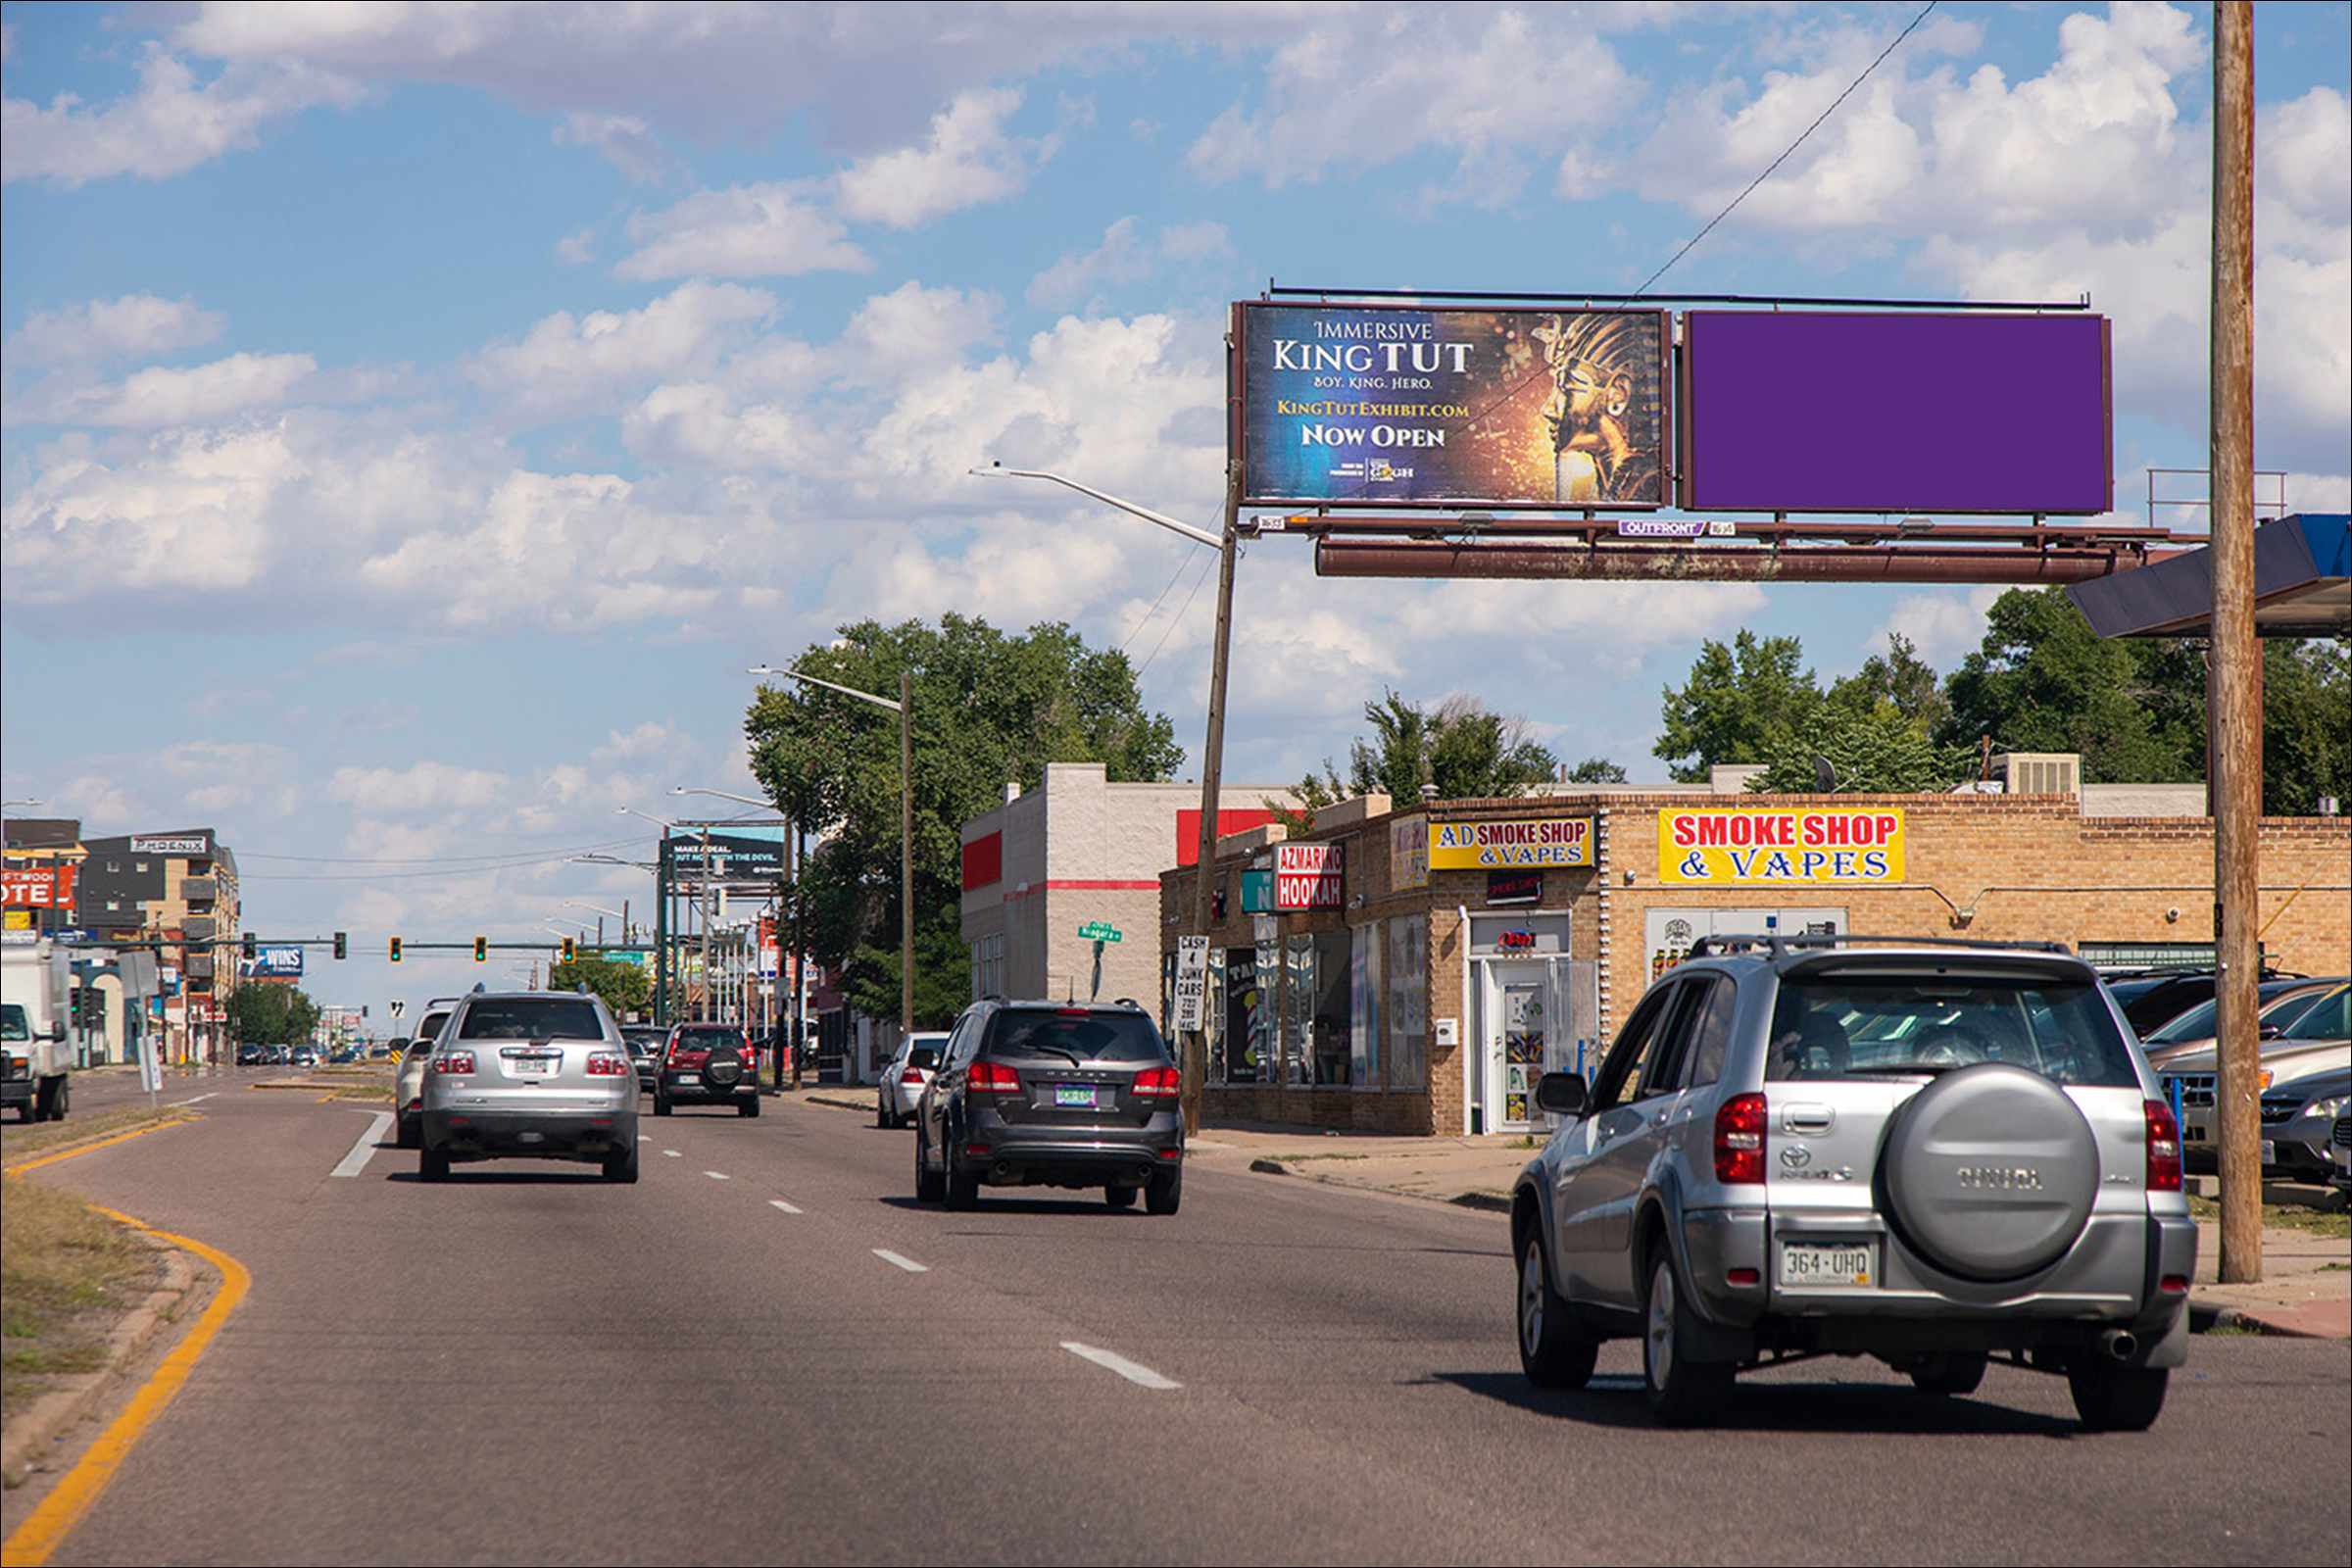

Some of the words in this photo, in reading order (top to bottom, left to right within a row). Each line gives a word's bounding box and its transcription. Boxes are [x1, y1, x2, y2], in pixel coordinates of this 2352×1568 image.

[1313, 320, 1433, 340] IMMERSIVE
[1273, 339, 1373, 371] KING
[1378, 342, 1474, 372] TUT
[1313, 376, 1345, 388] BOY.
[1348, 377, 1388, 390] KING.
[1392, 377, 1433, 390] HERO.
[1301, 423, 1365, 446] NOW
[1371, 424, 1446, 447] OPEN
[1627, 521, 1696, 534] OUTFRONT
[1440, 825, 1474, 847] AD
[1477, 824, 1536, 846] SMOKE
[1540, 822, 1586, 844] SHOP
[1674, 815, 1793, 845] SMOKE
[1804, 815, 1896, 845] SHOP
[1280, 847, 1342, 870] AZMARINO
[1480, 848, 1497, 863] &
[1500, 846, 1582, 863] VAPES
[1680, 851, 1710, 877] &
[1729, 848, 1887, 877] VAPES
[1280, 877, 1340, 905] HOOKAH
[1181, 937, 1205, 949] CASH
[267, 950, 300, 965] WINS
[1189, 952, 1196, 964] 4
[1179, 969, 1203, 980] JUNK
[1177, 983, 1202, 996] CARS
[1957, 1167, 2043, 1190] TOYOTA
